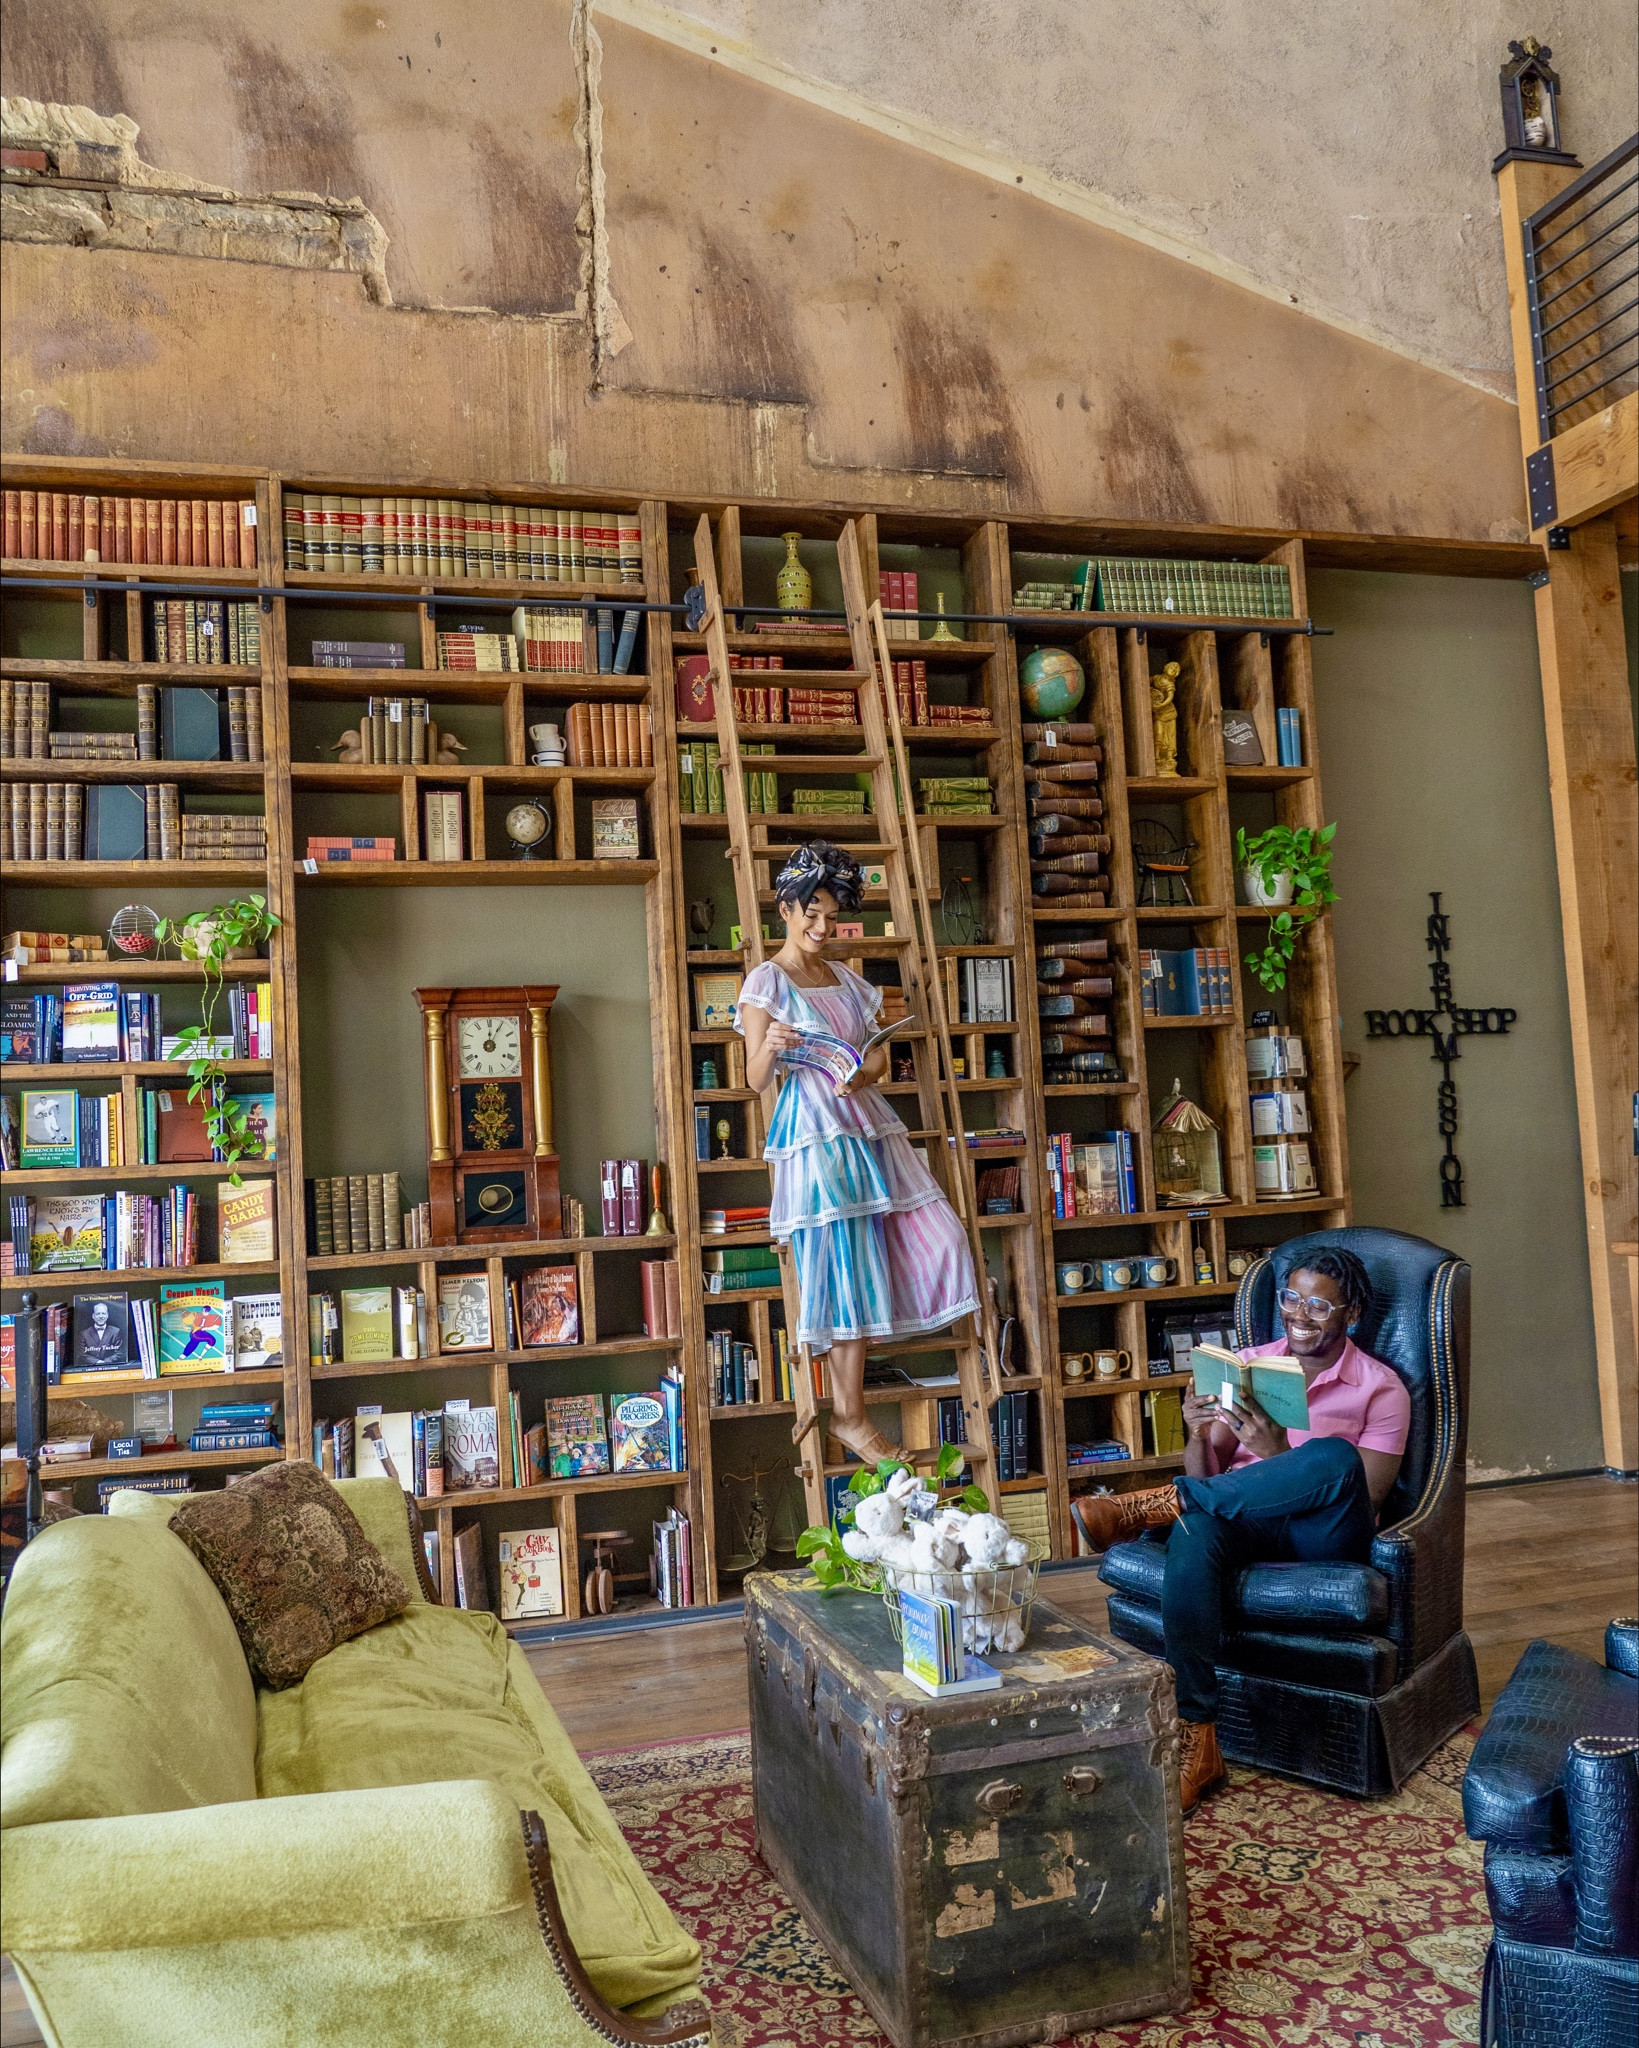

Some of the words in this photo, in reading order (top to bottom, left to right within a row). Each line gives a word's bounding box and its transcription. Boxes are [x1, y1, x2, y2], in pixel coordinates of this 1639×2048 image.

[69, 985, 100, 993] SURVIVING
[69, 991, 114, 1001] OFF-GRID
[1364, 1010, 1442, 1036] BOOK
[1451, 1008, 1517, 1034] SHOP
[1427, 892, 1466, 1207] INTERMISSION
[1064, 1136, 1072, 1153] Civil
[1053, 1145, 1062, 1162] Civil
[1066, 1181, 1074, 1207] Swords
[61, 1199, 80, 1207] GOD
[81, 1198, 100, 1206] WHO
[223, 1192, 265, 1215] CANDY
[49, 1207, 80, 1215] KNOWS
[229, 1205, 267, 1226] BARR
[241, 1302, 281, 1320] CAPTURED
[200, 1318, 206, 1327] 1
[0, 1345, 15, 1359] ugs
[562, 1410, 581, 1418] Family
[621, 1404, 659, 1413] PILGRIM'S
[446, 1412, 495, 1423] STEVEN
[620, 1412, 661, 1421] PROGRESS
[447, 1422, 496, 1434] SAYLOR
[113, 1439, 134, 1448] Local
[428, 1421, 440, 1468] EMPIRE
[447, 1433, 497, 1460] ROMA
[116, 1448, 130, 1456] Ties
[135, 1481, 160, 1489] PEOPLES
[525, 1534, 550, 1548] Gay
[902, 1602, 930, 1625] RUNAWAY
[911, 1623, 934, 1642] BUNNY
